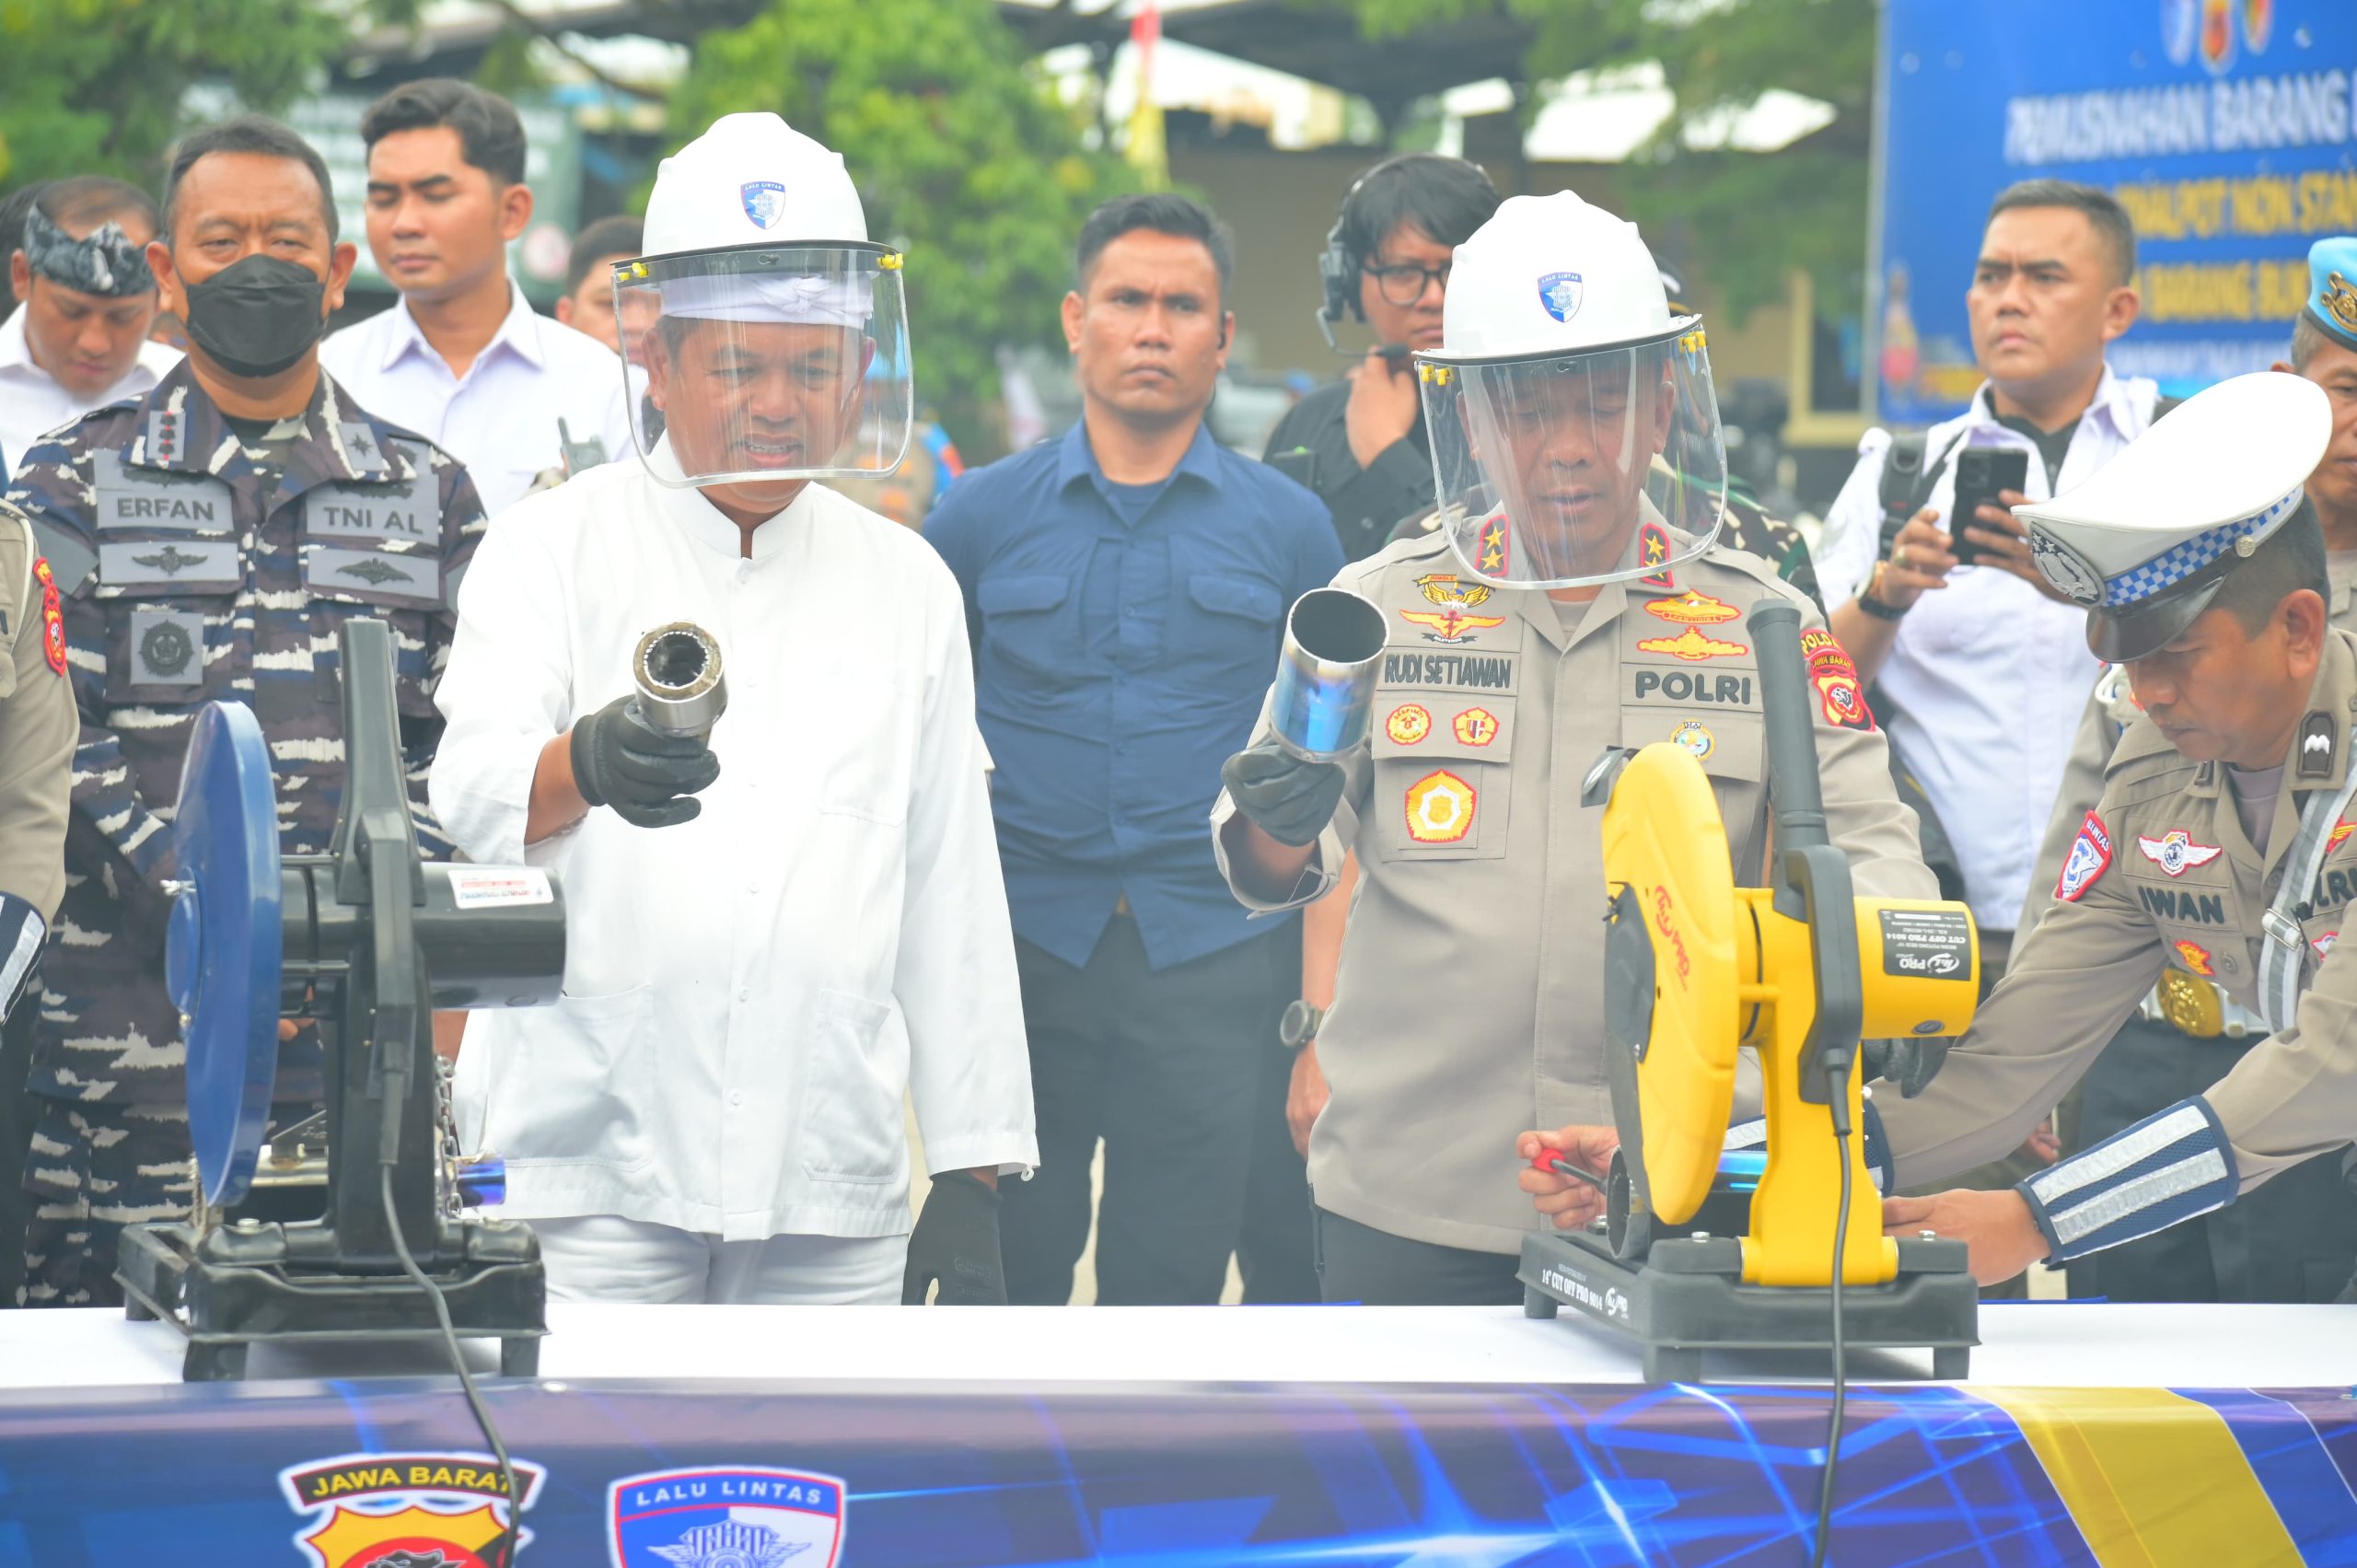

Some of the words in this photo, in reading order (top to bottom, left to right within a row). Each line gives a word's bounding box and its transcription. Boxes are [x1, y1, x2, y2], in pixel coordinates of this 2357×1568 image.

[2213, 70, 2347, 150] BARANG
[2118, 180, 2225, 239] NALPOT
[2234, 175, 2292, 233] NON
[117, 497, 215, 521] ERFAN
[323, 506, 372, 528] TNI
[384, 511, 424, 535] AL
[1384, 654, 1422, 683] RUDI
[1424, 655, 1512, 689] SETIAWAN
[1635, 670, 1751, 704] POLRI
[2138, 885, 2225, 924] IWAN
[1908, 934, 1927, 942] PRO
[1928, 935, 1946, 943] OFF
[1948, 935, 1966, 944] CUT
[1899, 958, 1926, 970] PRO
[1552, 1272, 1564, 1291] CUT
[1564, 1277, 1576, 1297] OFF
[1576, 1283, 1589, 1304] PRO
[313, 1468, 401, 1497] JAWA
[636, 1482, 707, 1506] LALU
[722, 1481, 822, 1504] LINTAS
